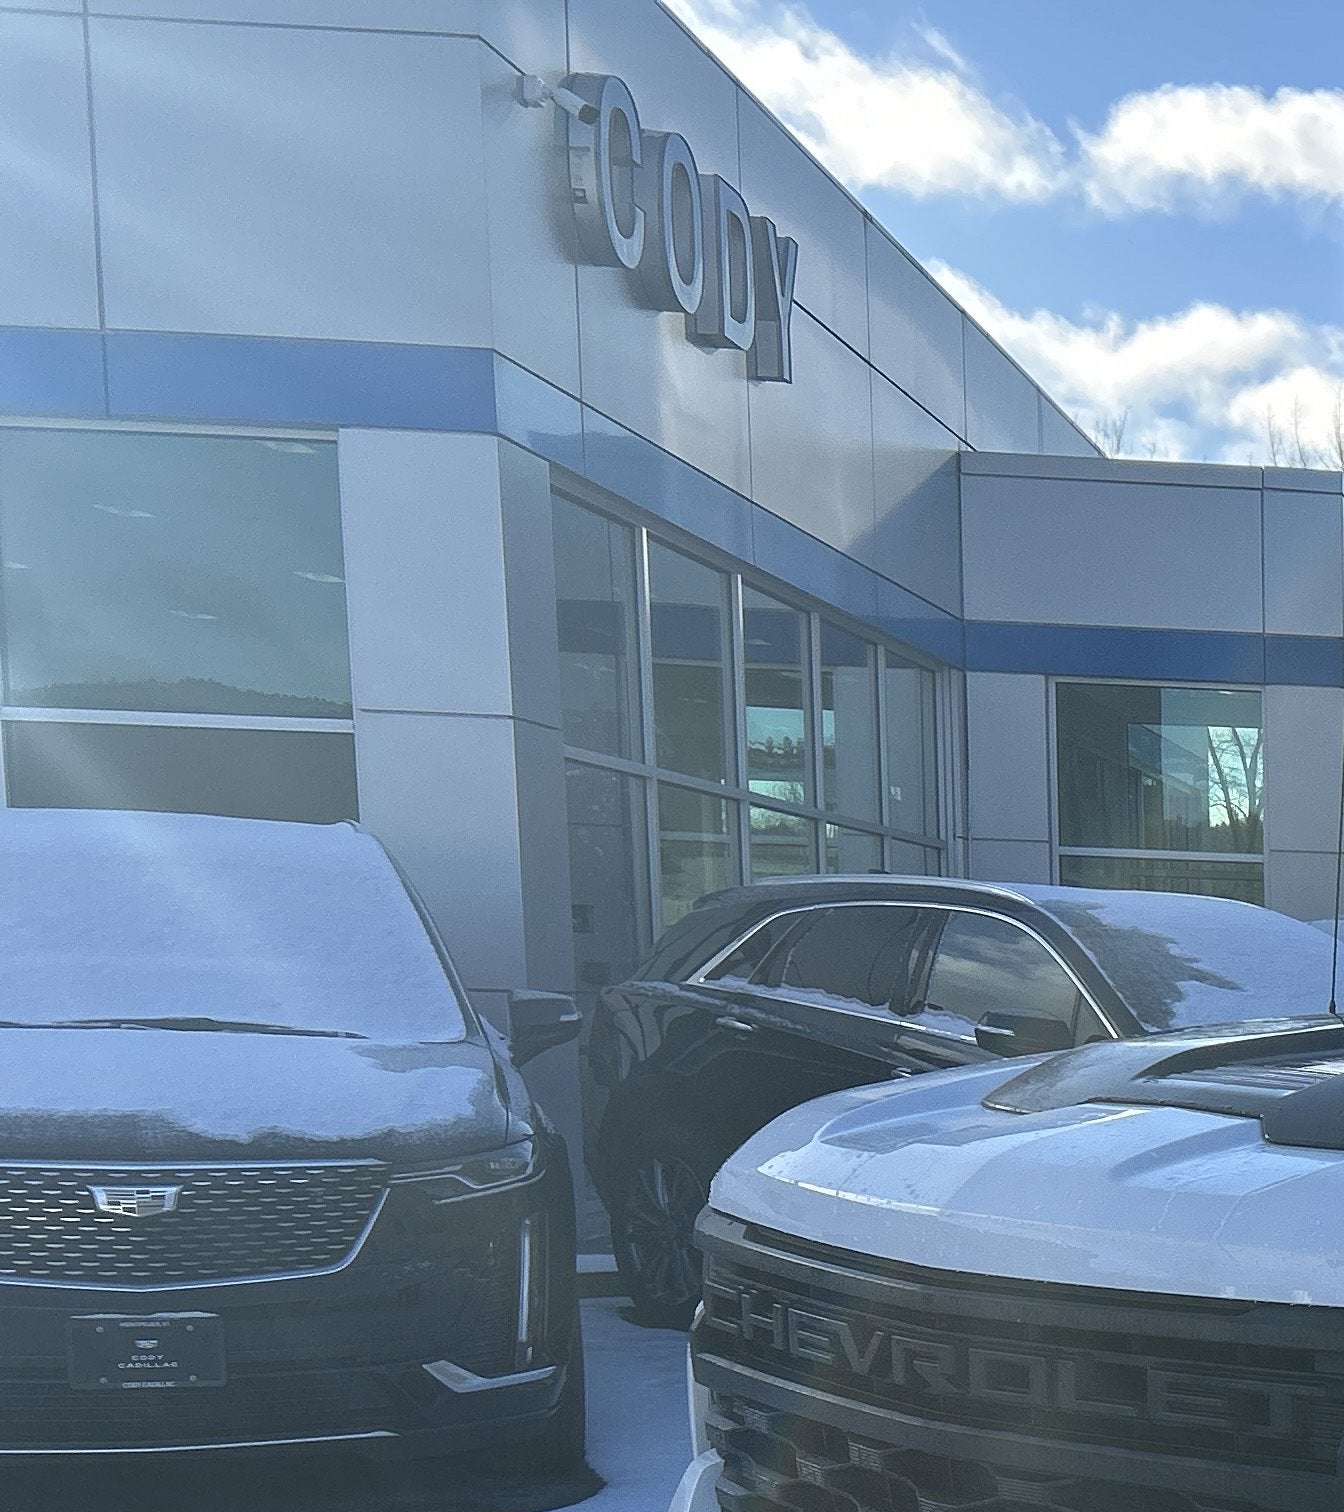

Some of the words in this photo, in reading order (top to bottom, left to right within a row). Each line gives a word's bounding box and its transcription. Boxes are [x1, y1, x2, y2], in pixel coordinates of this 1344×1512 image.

[598, 74, 799, 384] CODY
[117, 1361, 178, 1369] CADILLAC
[703, 1281, 1327, 1436] CHEVROLET
